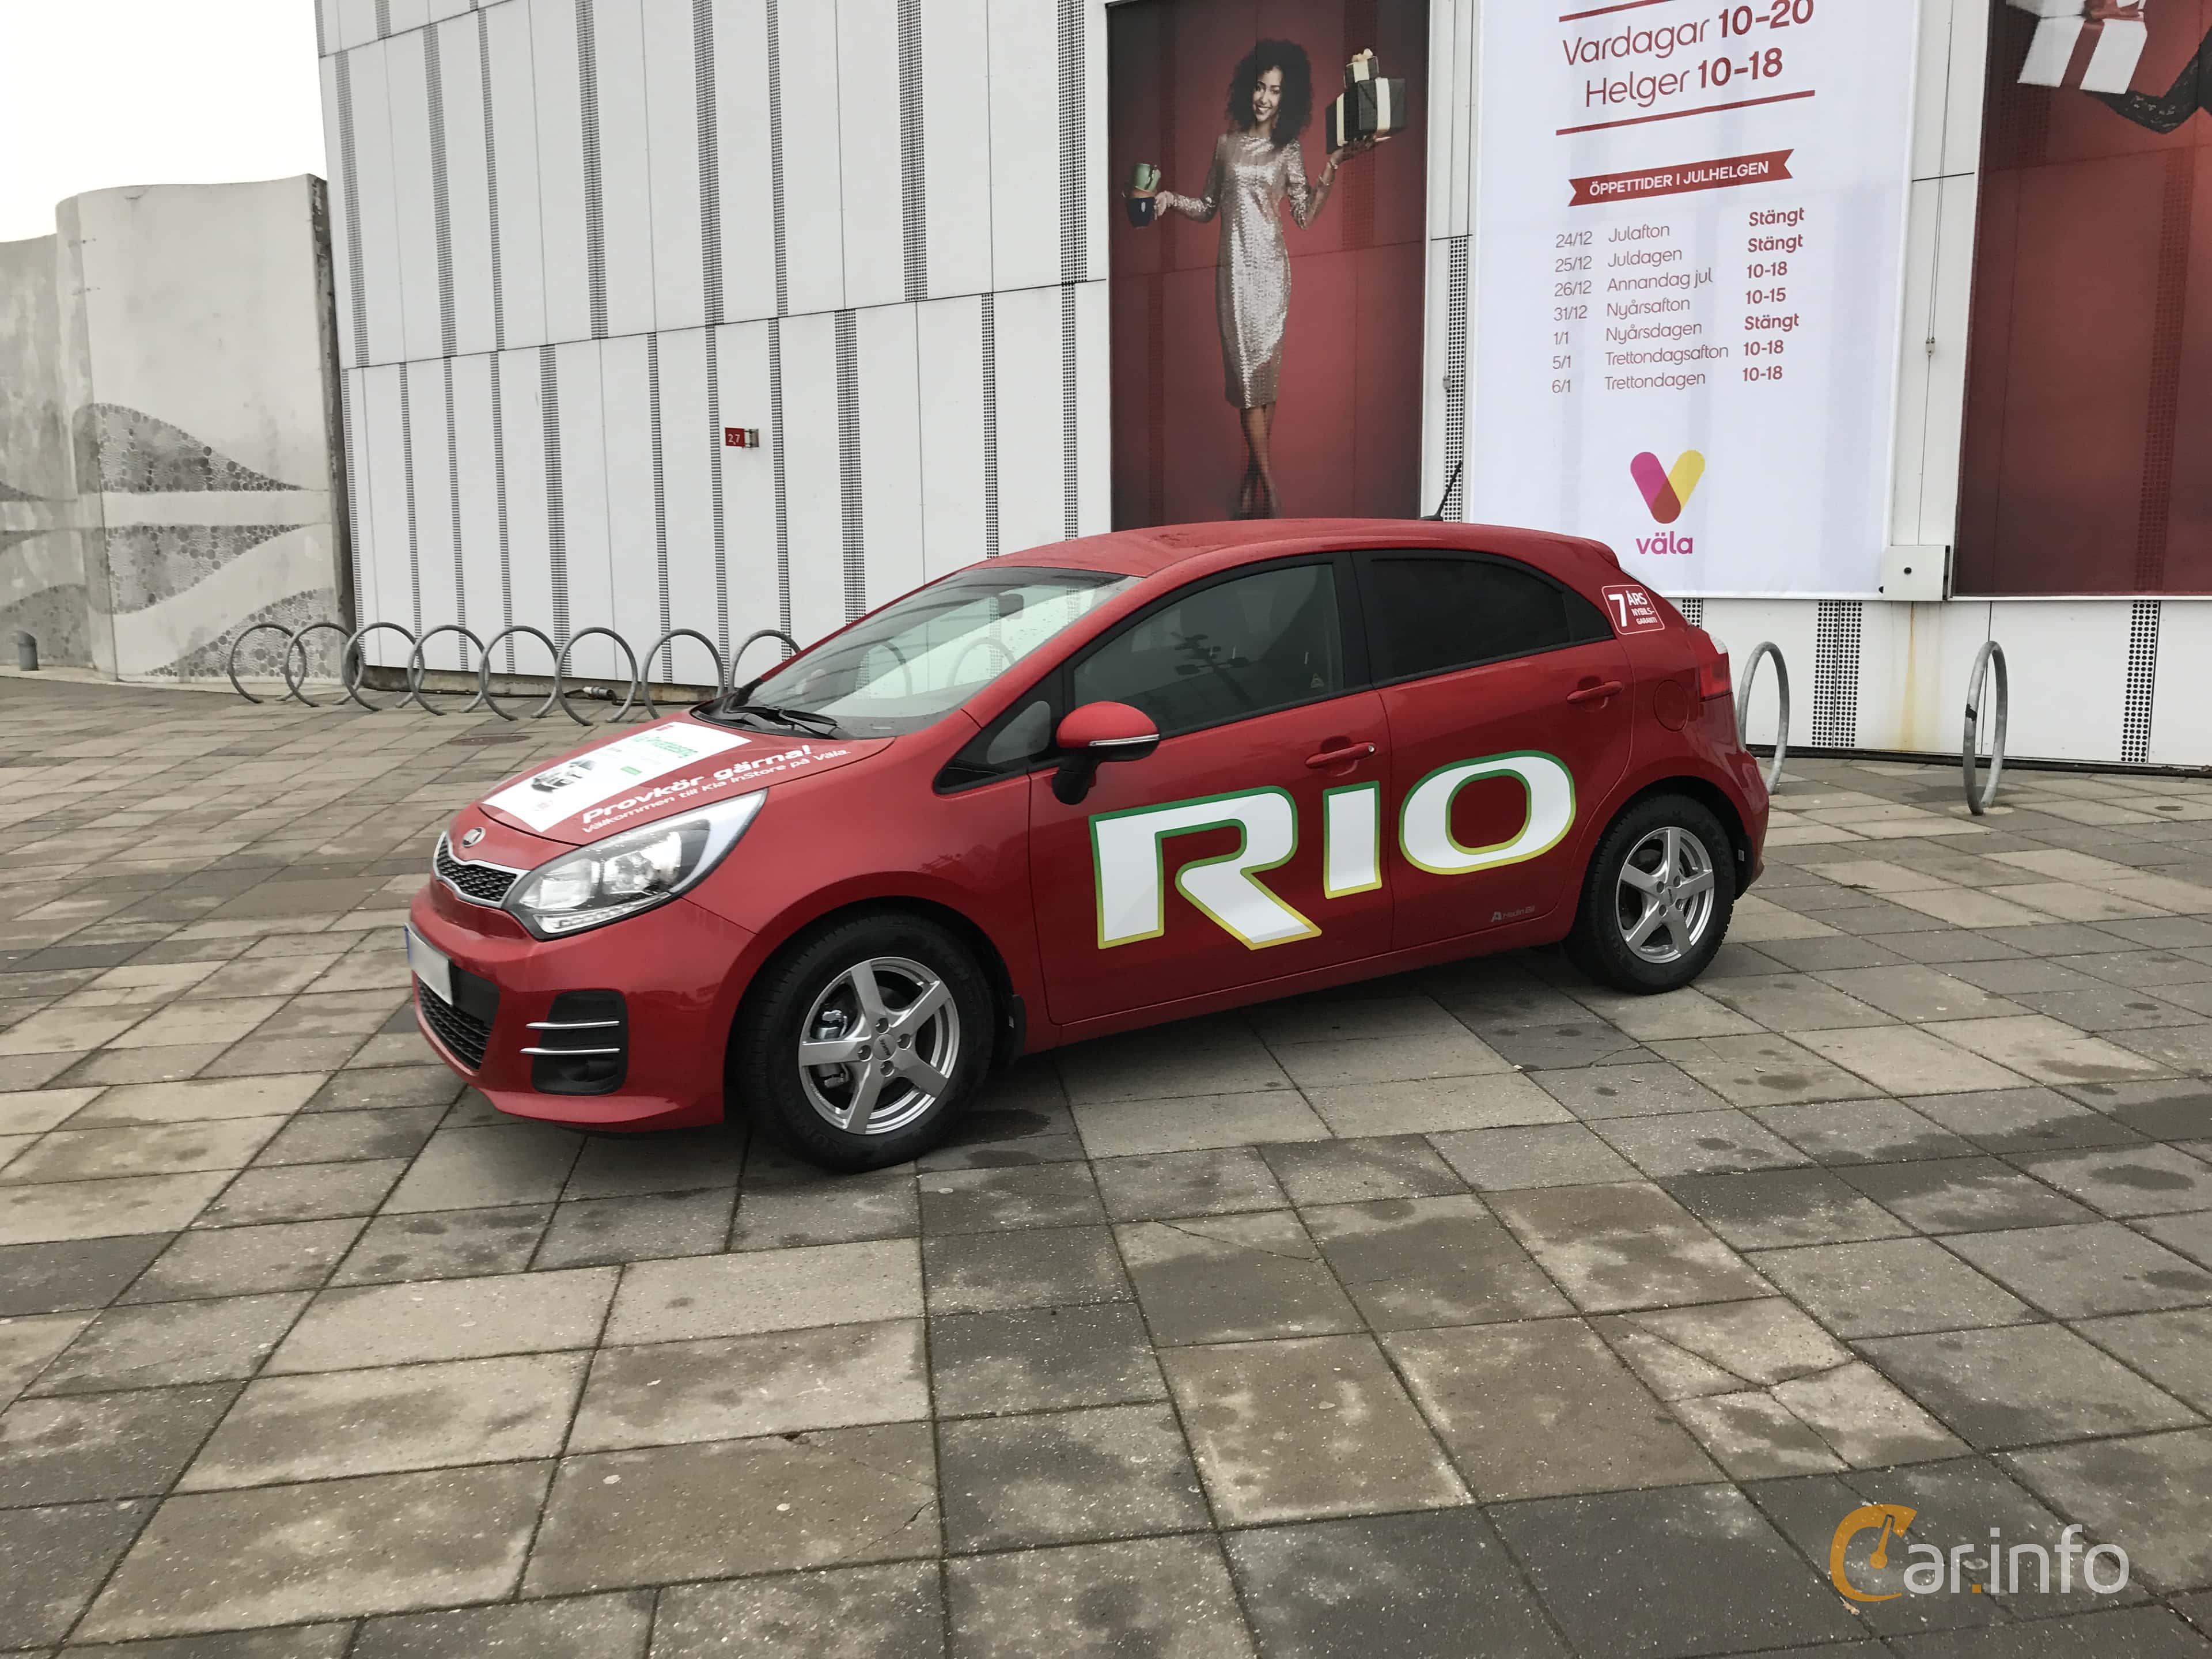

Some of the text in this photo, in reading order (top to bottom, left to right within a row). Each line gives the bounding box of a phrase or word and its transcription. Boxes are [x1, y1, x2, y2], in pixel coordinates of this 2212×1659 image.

[1562, 0, 1814, 65] Vardagar 10-20
[1586, 47, 1783, 108] Helger 10-18
[1589, 161, 1769, 196] ÖPPETTIDER I JULHELGEN
[1555, 207, 1805, 248] 24/12 Julafton Stängt
[1555, 234, 1804, 272] 25/12 Juldagen Stängt
[1554, 261, 1787, 297] 26/12 Annandag jul 10-18
[1553, 287, 1786, 321] 31/12 Nyårsafton 10-15
[1553, 313, 1800, 345] 1/1 Nyårsdagen Stängt
[1552, 339, 1784, 369] 5/1 Trettondagsafton 10-18
[1552, 365, 1783, 393] 6/1 Trettondagen 10-18
[1635, 531, 1694, 554] väla
[1608, 590, 1647, 627] 7 ÅRS
[582, 776, 704, 824] Provkör
[713, 745, 812, 781] gärna!
[679, 789, 699, 798] till
[790, 757, 810, 768] på
[1089, 750, 1577, 951] RIO
